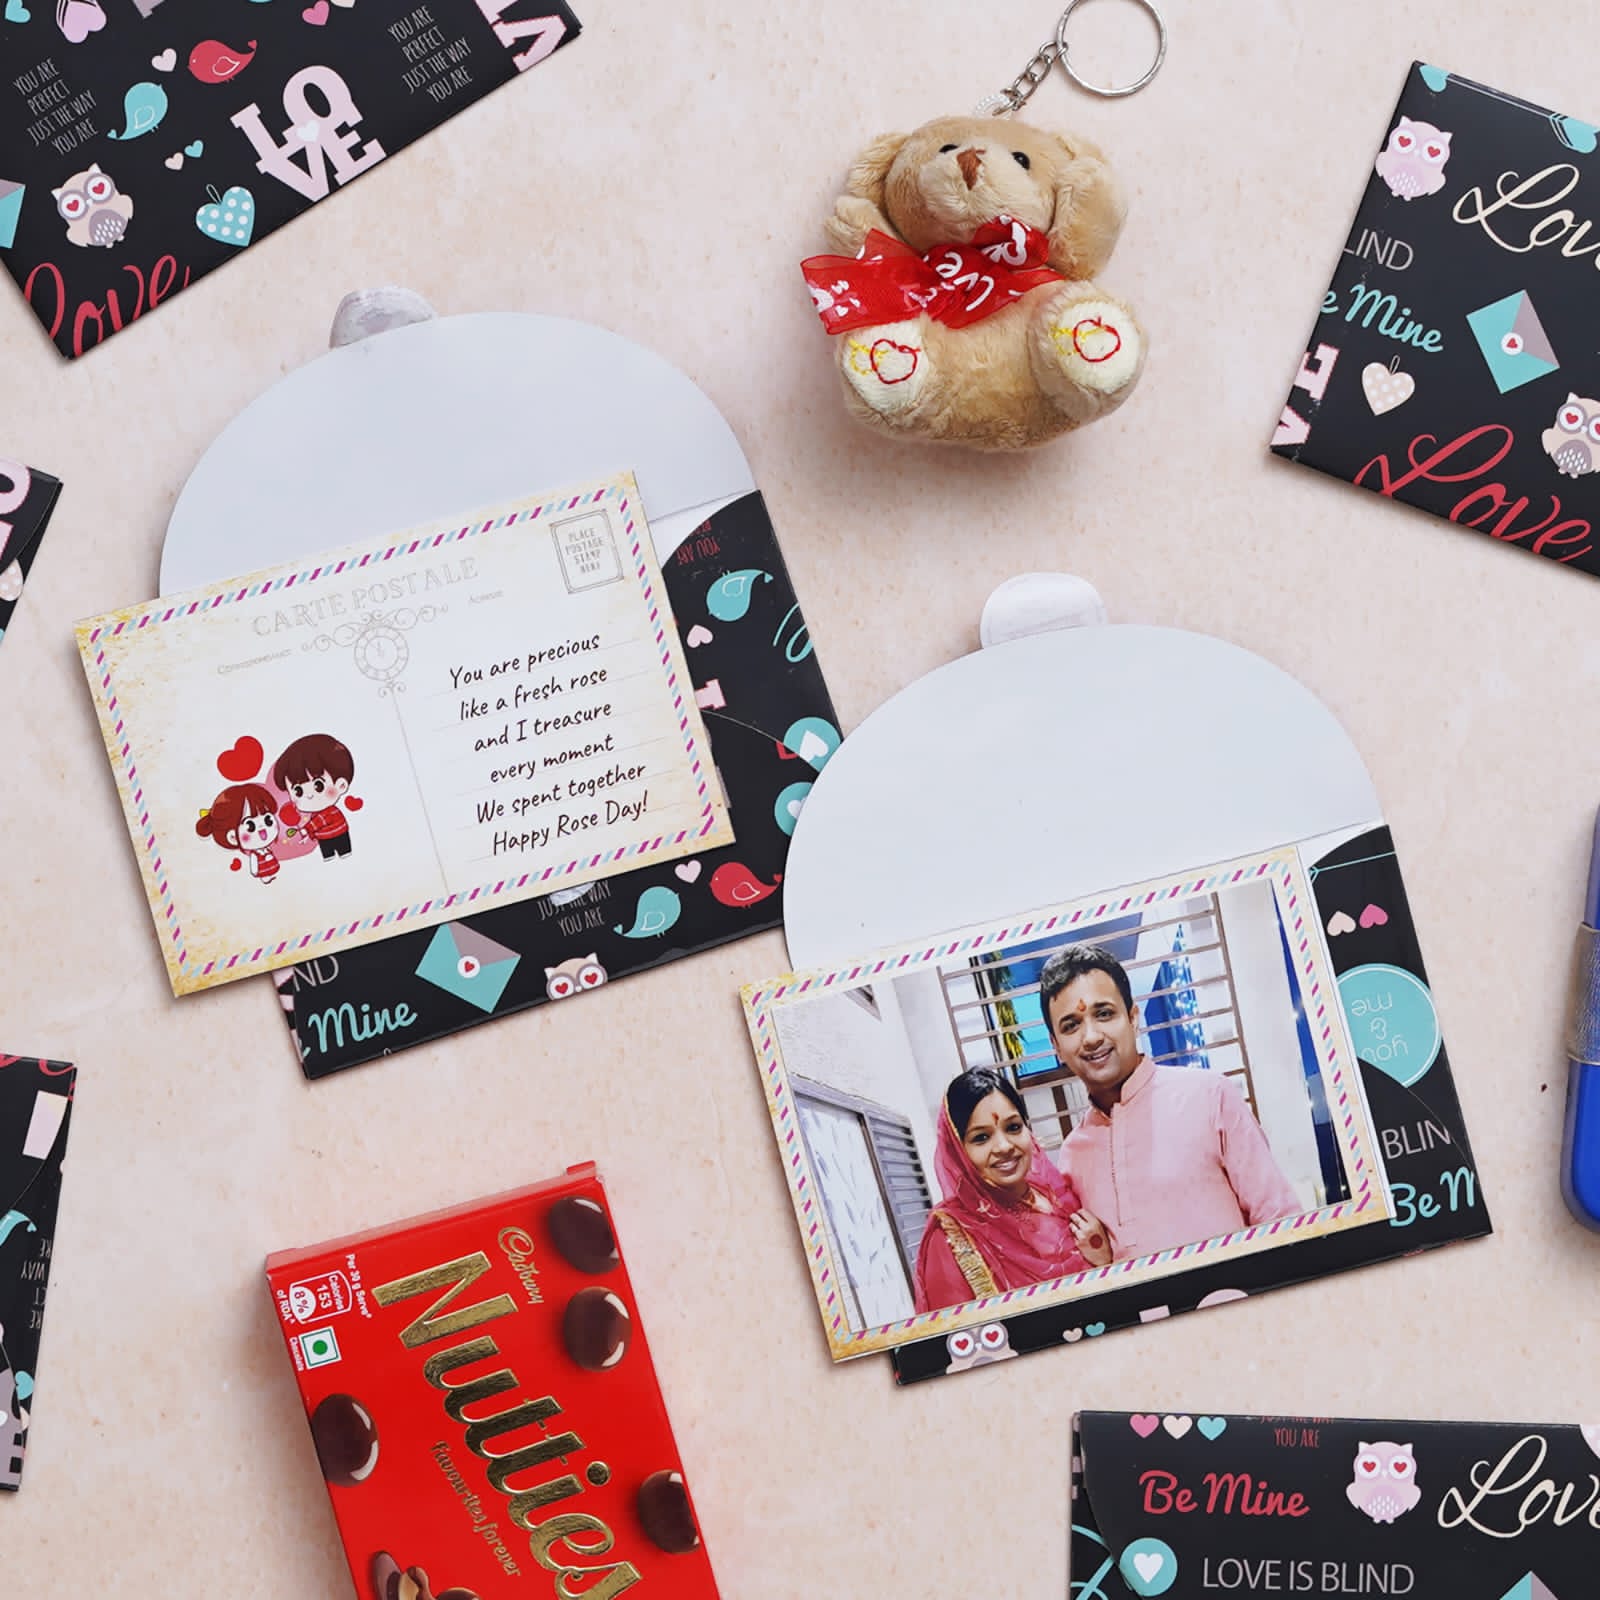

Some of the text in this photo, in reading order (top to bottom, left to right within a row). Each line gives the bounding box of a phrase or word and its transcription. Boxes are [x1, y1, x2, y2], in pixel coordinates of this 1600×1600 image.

[387, 5, 435, 44] YOU ARE
[401, 25, 447, 63] PERFECT
[13, 58, 60, 96] YOU ARE
[402, 36, 473, 95] JUST THE WAY
[426, 65, 474, 104] YOU ARE
[26, 89, 97, 147] JUST THE WAY
[27, 79, 71, 116] PERFECT
[51, 117, 99, 156] YOU ARE
[1452, 163, 1600, 271] Lov
[1344, 283, 1443, 353] Mine
[252, 594, 349, 637] CARTE
[449, 634, 601, 690] You are precious
[460, 668, 609, 721] like a fresh rose
[474, 702, 613, 752] and I treasure
[490, 734, 615, 784] every moment
[477, 763, 647, 825] We spent together
[492, 790, 649, 857] Happy Rose Day!
[557, 906, 606, 937] YOU ARE
[1350, 991, 1394, 1017] me
[308, 1002, 418, 1053] Mine
[1389, 1183, 1441, 1228] Be
[345, 1253, 357, 1269] Per
[497, 1225, 545, 1306] Cadbury
[294, 1289, 310, 1314] 8%
[316, 1284, 333, 1309] 153
[328, 1275, 344, 1310] Calories
[371, 1250, 643, 1600] Nutties
[1274, 1427, 1320, 1448] YOU ARE
[1138, 1469, 1310, 1518] Be Mine
[472, 1516, 523, 1580] forever
[1202, 1556, 1415, 1595] LOVE IS BLIND
